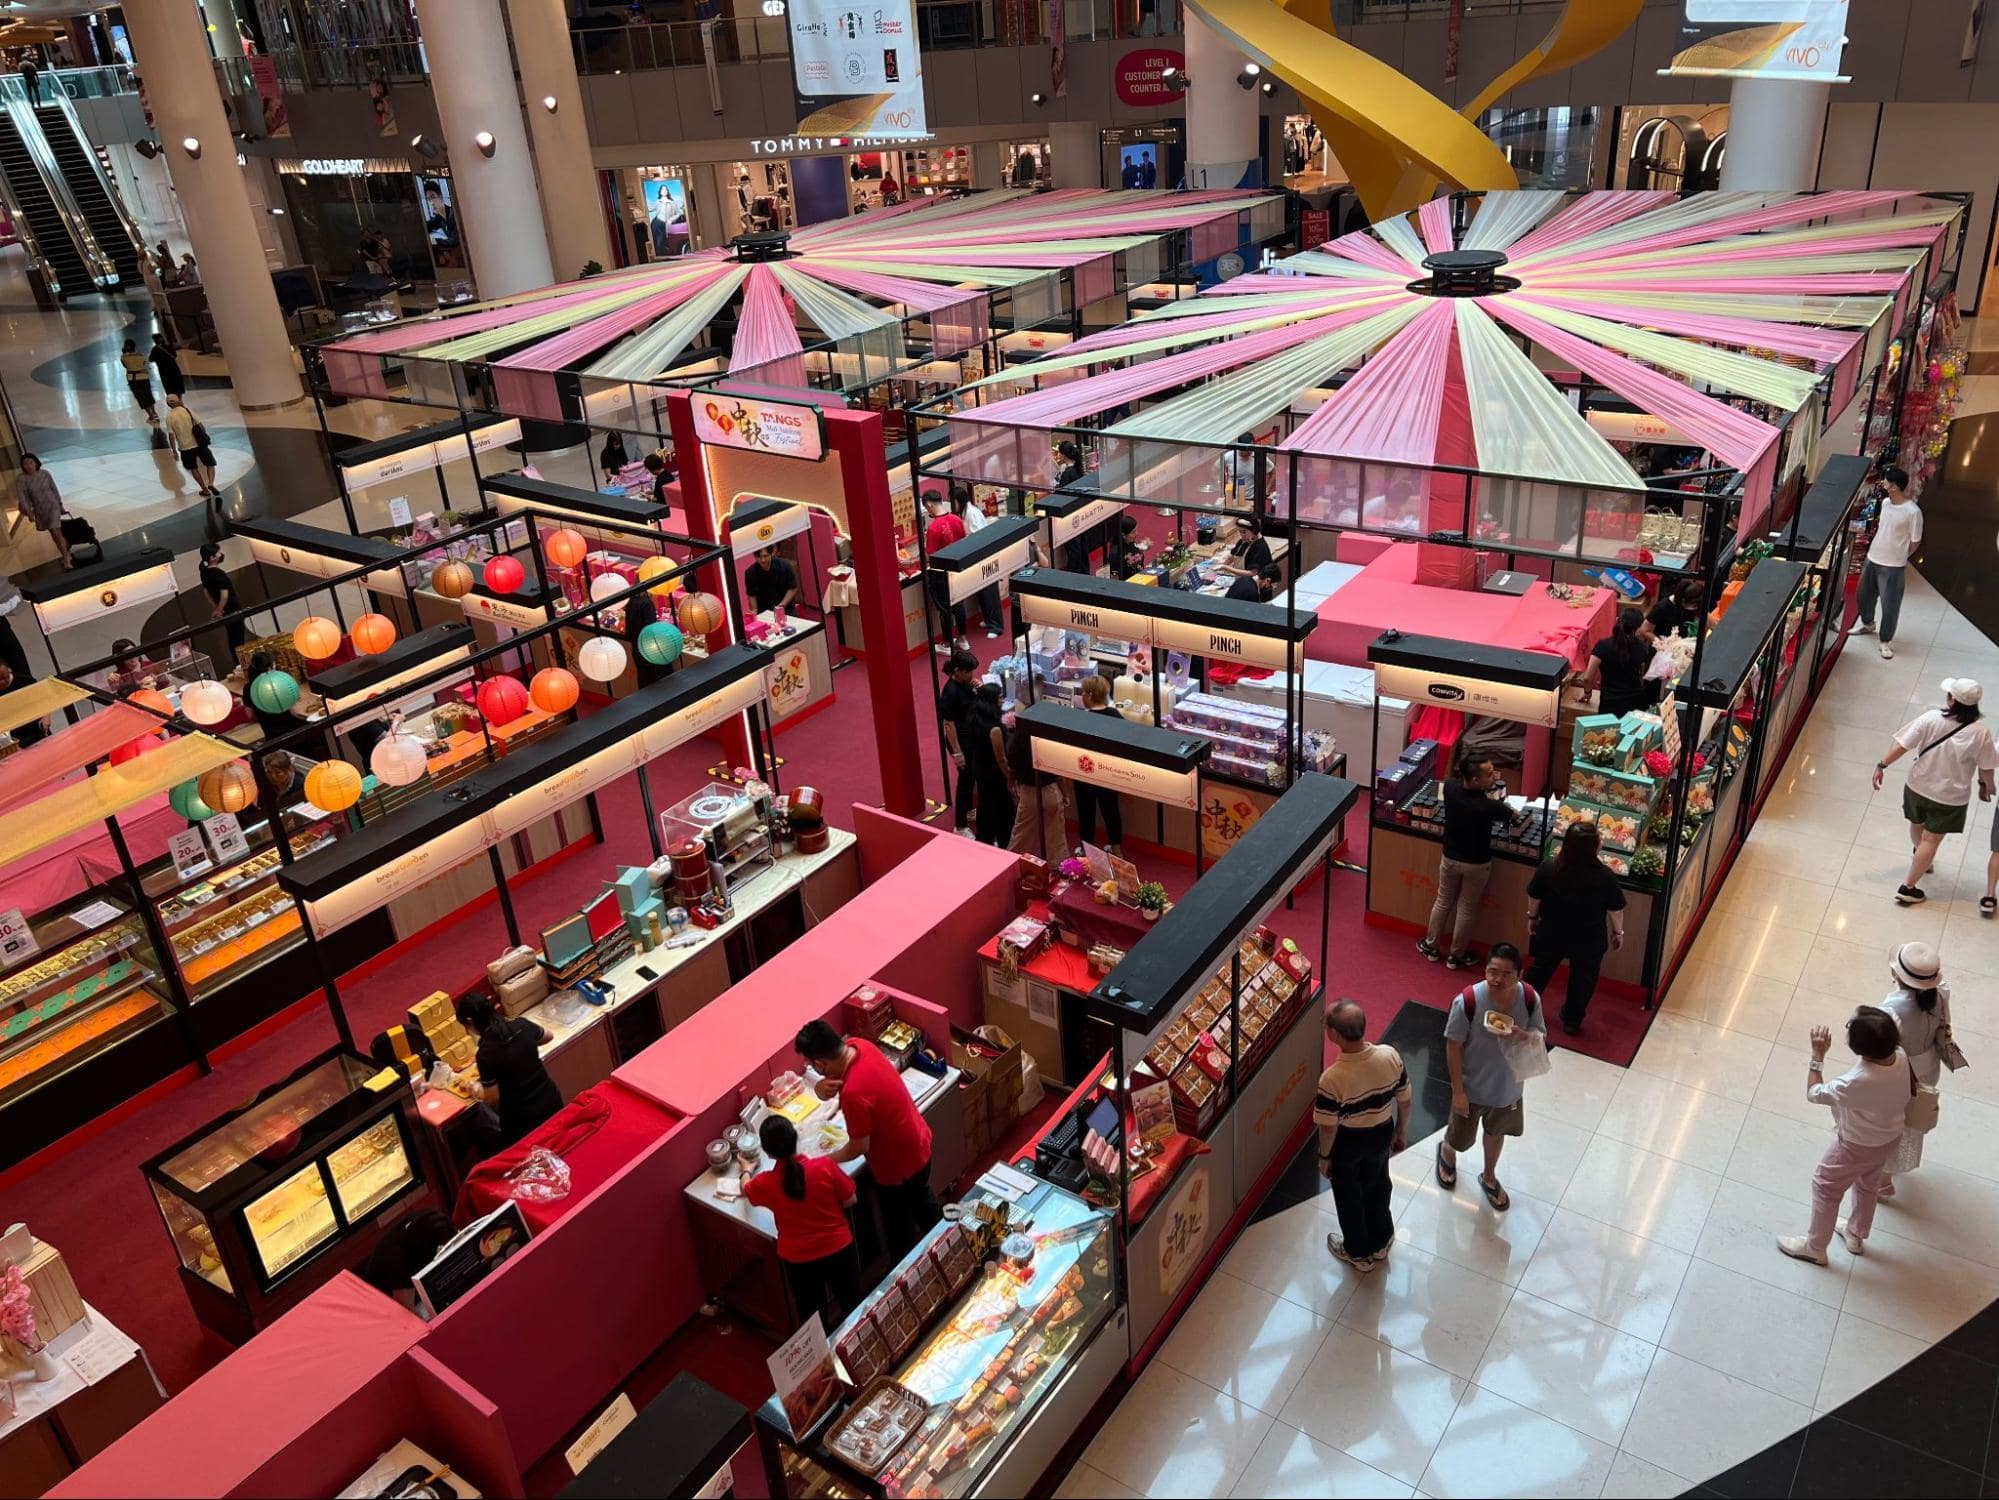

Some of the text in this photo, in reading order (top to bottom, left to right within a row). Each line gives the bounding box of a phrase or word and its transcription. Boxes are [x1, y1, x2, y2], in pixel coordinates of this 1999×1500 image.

[1145, 58, 1164, 67] LEVEL
[1124, 71, 1161, 81] CUSTOMER
[1130, 84, 1161, 93] COUNTER
[751, 138, 825, 153] TOMMY
[303, 159, 365, 174] GOLDHEART
[1191, 169, 1208, 188] L1
[760, 412, 802, 427] TANGS
[1210, 634, 1241, 654] PINCH
